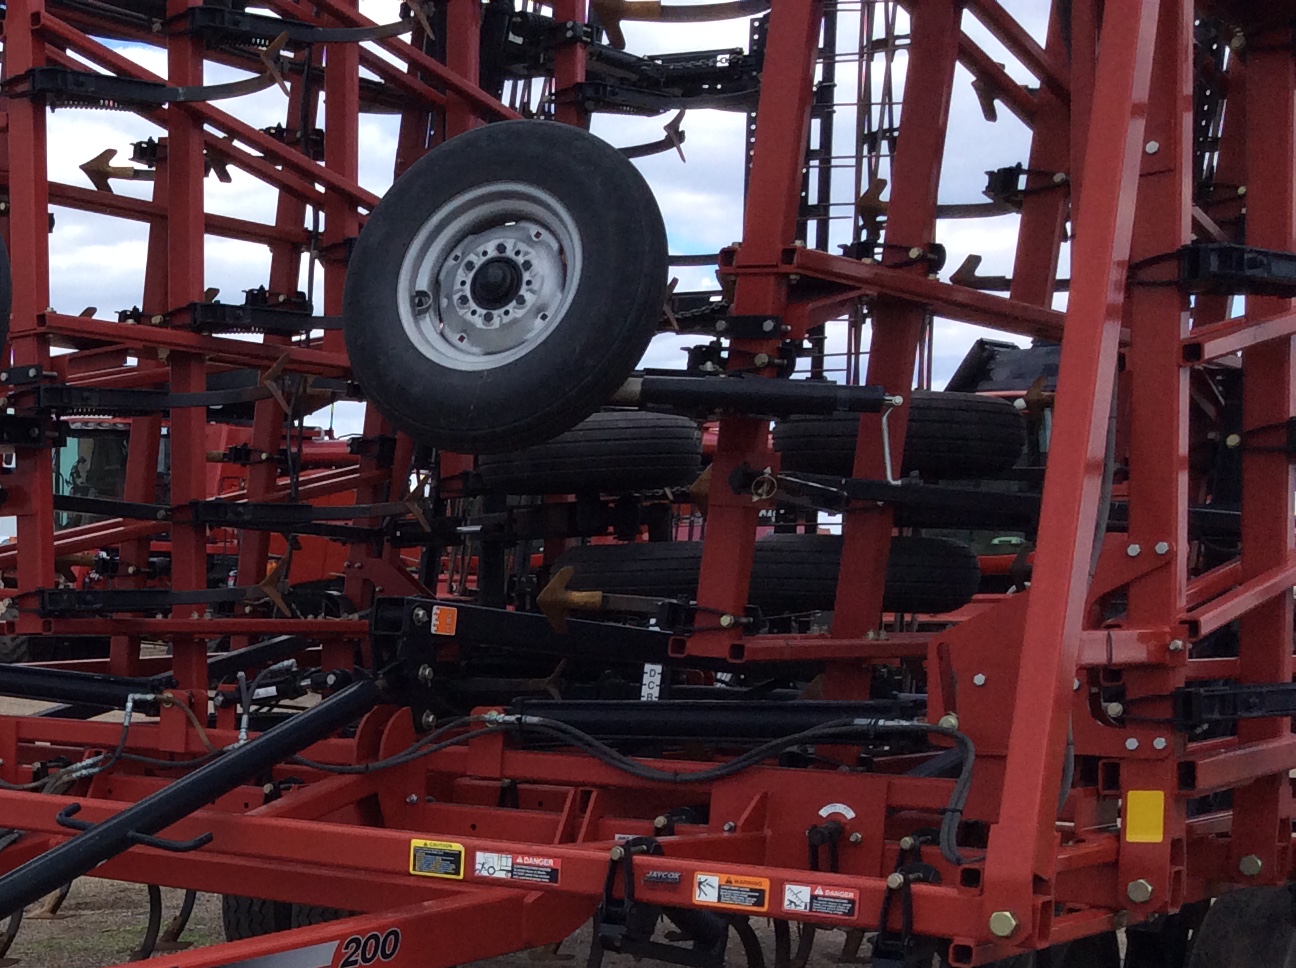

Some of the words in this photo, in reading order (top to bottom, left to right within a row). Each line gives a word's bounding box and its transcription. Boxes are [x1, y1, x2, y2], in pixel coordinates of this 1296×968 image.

[649, 669, 657, 678] D
[647, 681, 655, 690] C
[523, 856, 554, 866] DANGER
[824, 889, 854, 899] DANGER
